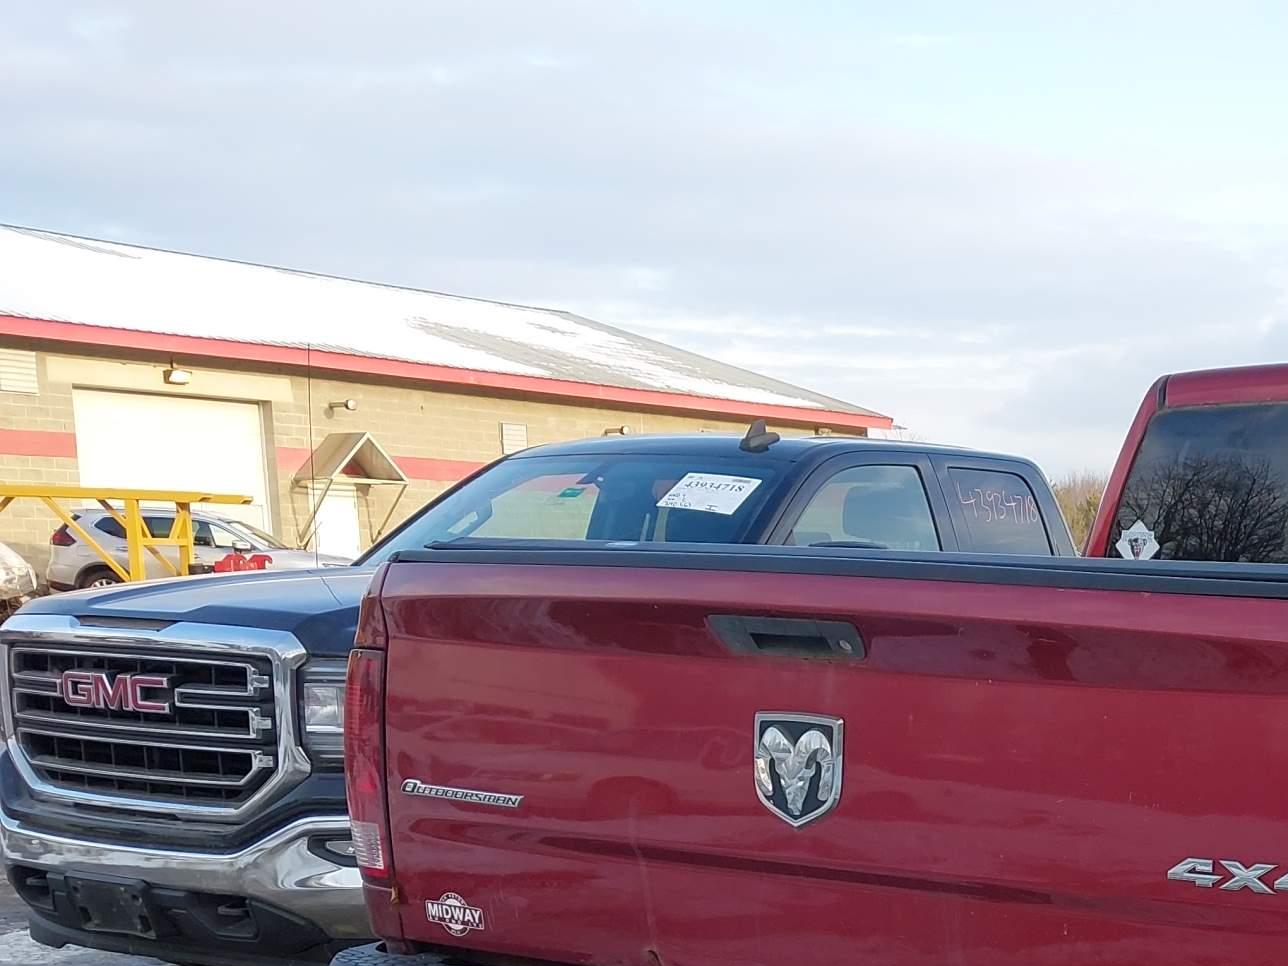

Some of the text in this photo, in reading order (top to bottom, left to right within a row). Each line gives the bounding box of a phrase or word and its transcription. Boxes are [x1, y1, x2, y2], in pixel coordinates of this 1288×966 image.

[957, 481, 1038, 523] 43934718
[62, 670, 170, 714] GMC
[427, 902, 481, 924] MIDWAY
